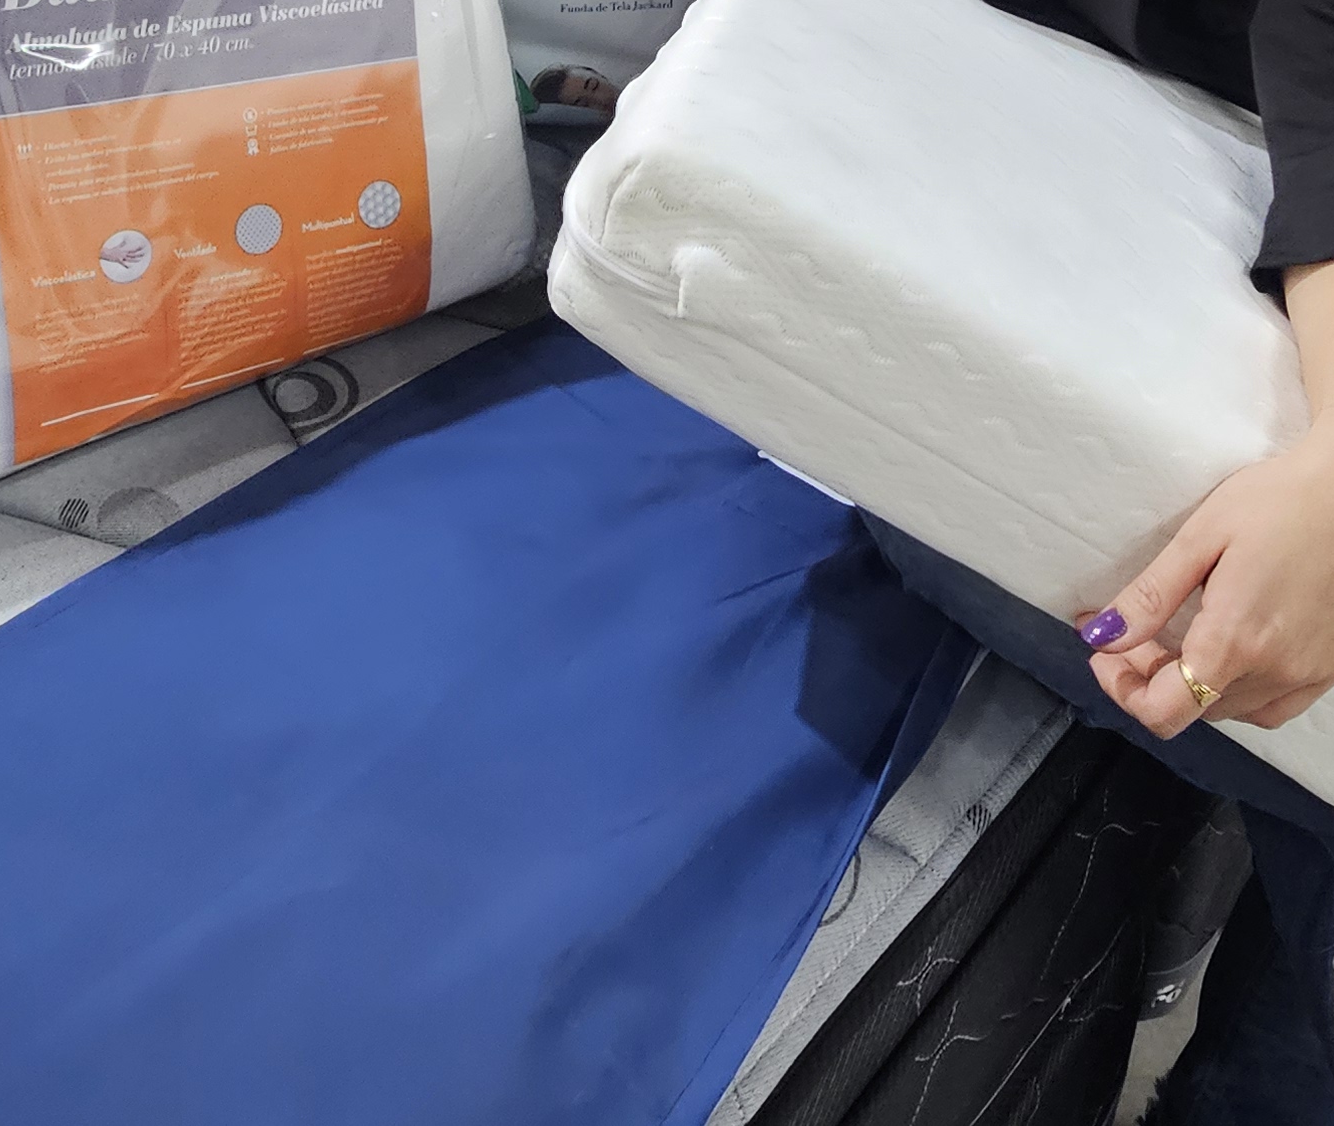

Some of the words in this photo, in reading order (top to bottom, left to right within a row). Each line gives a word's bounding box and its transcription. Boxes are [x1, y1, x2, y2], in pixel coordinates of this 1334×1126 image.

[560, 2, 594, 13] Funda
[596, 2, 608, 12] de
[610, 0, 632, 12] Tela
[6, 20, 127, 55] Almohada
[133, 14, 161, 37] de
[167, 11, 252, 42] Espuma
[154, 41, 176, 61] 70
[180, 44, 193, 58] x
[197, 35, 221, 55] 40
[301, 212, 355, 233] Multipuntual
[174, 242, 217, 260] Ventilado
